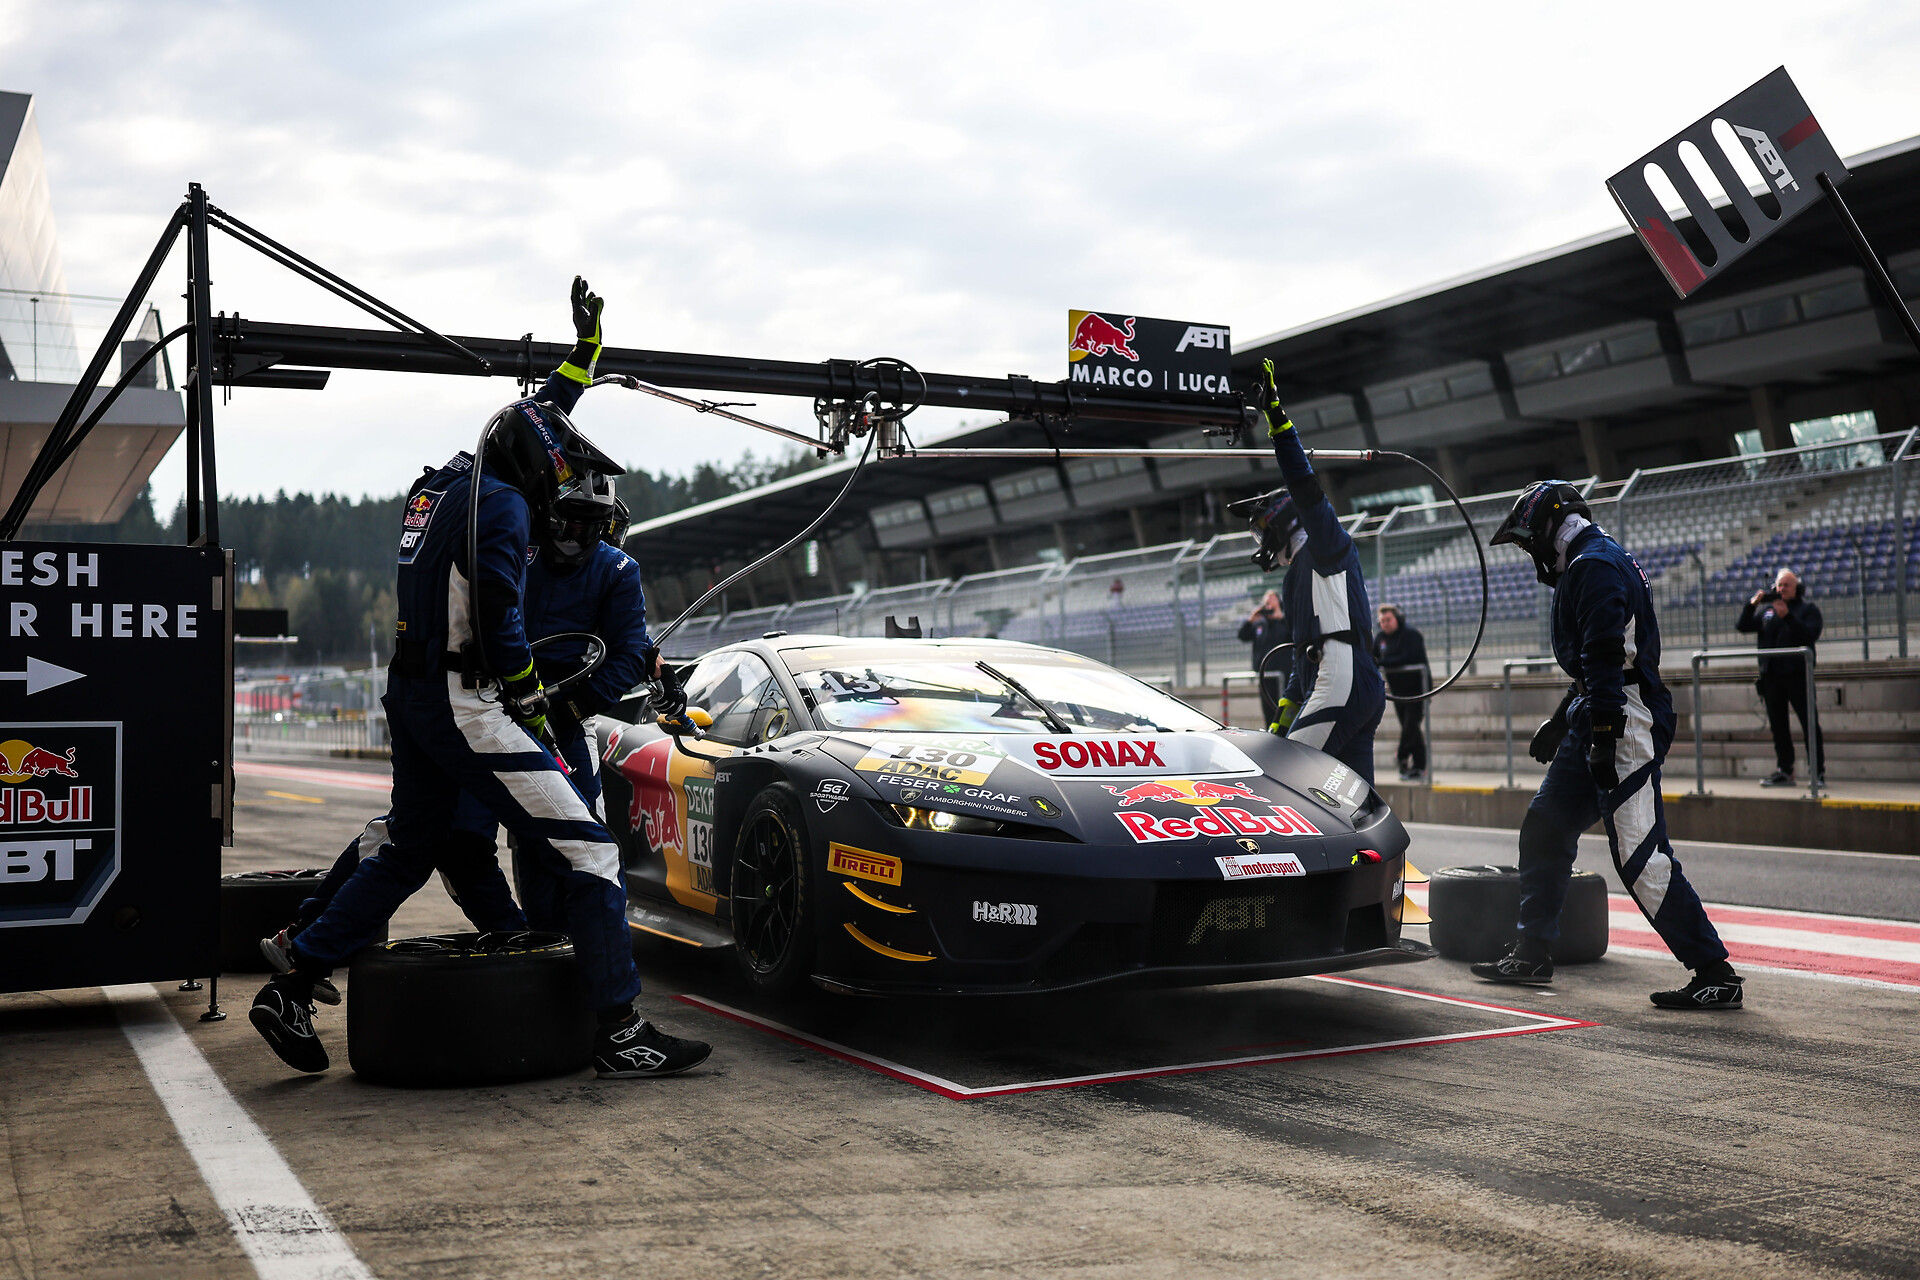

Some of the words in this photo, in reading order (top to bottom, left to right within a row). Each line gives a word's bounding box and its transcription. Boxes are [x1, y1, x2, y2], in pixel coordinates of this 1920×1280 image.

[1733, 124, 1800, 192] ABT
[1175, 325, 1230, 353] ABT
[1072, 363, 1153, 388] MARCO
[1178, 372, 1231, 394] LUCA
[537, 423, 553, 445] SPECT
[10, 602, 38, 637] R
[71, 602, 198, 638] HERE
[890, 745, 977, 767] 130
[1033, 740, 1167, 770] SONAX
[714, 772, 731, 784] ABT
[877, 761, 963, 782] ADAC
[810, 792, 850, 801] SPORTWAGEN
[822, 783, 843, 794] SG
[876, 774, 940, 791] FESER
[964, 787, 1021, 803] GRAF
[924, 794, 982, 809] LAMBORGHINI
[983, 803, 1028, 817] NÜRNBERG
[833, 848, 896, 879] PIRELLI
[1241, 861, 1301, 876] motorsport
[973, 901, 1015, 925] H&R
[1187, 896, 1274, 944] ABT
